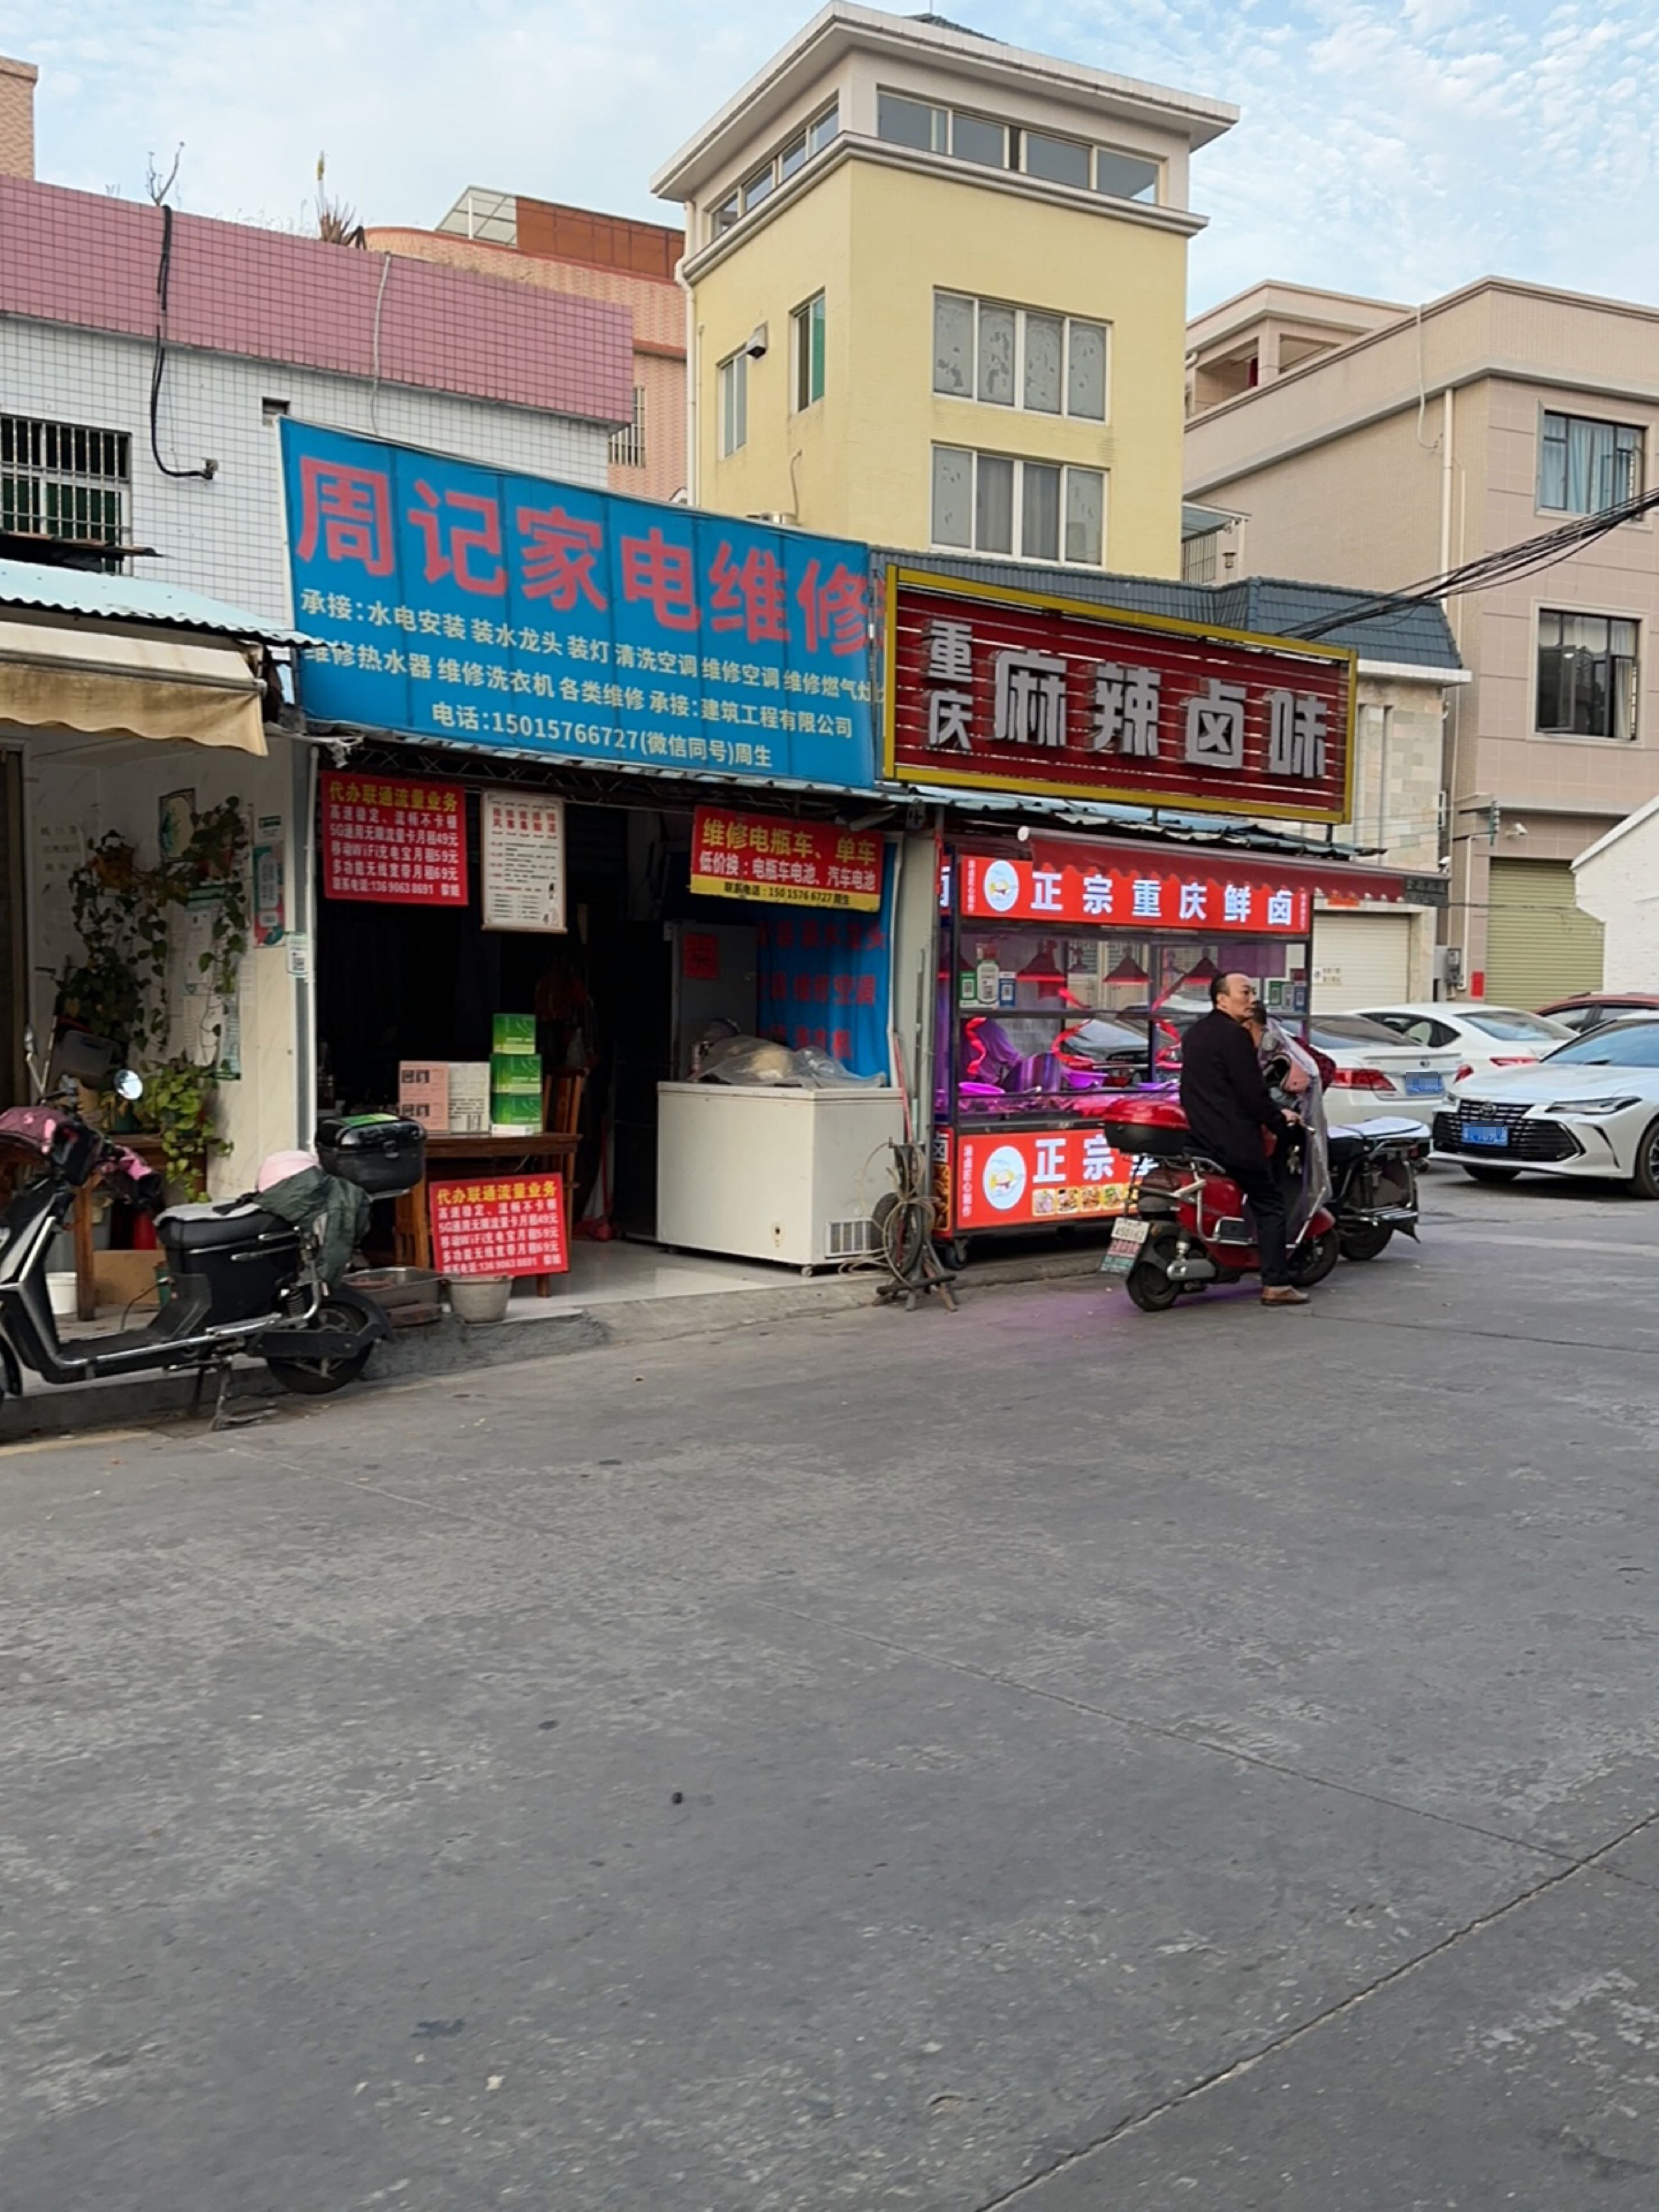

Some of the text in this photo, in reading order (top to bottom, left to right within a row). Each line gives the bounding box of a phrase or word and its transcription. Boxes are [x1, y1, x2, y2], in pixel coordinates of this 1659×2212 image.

[296, 456, 869, 657] 周记家电维修
[300, 588, 467, 640] 承接:水电安装
[470, 618, 563, 657] 装水龙头
[567, 635, 610, 664] 装灯
[615, 642, 698, 679] 清洗空调
[701, 656, 781, 691] 维修空调
[437, 656, 554, 699] 维修洗衣机
[559, 676, 646, 712] 各类维修
[650, 691, 853, 738] 承接:建筑工程有限公司
[927, 619, 973, 752] 重庆
[992, 648, 1327, 778] 麻辣卤味
[1030, 870, 1294, 926] 正宗重庆鲜卤
